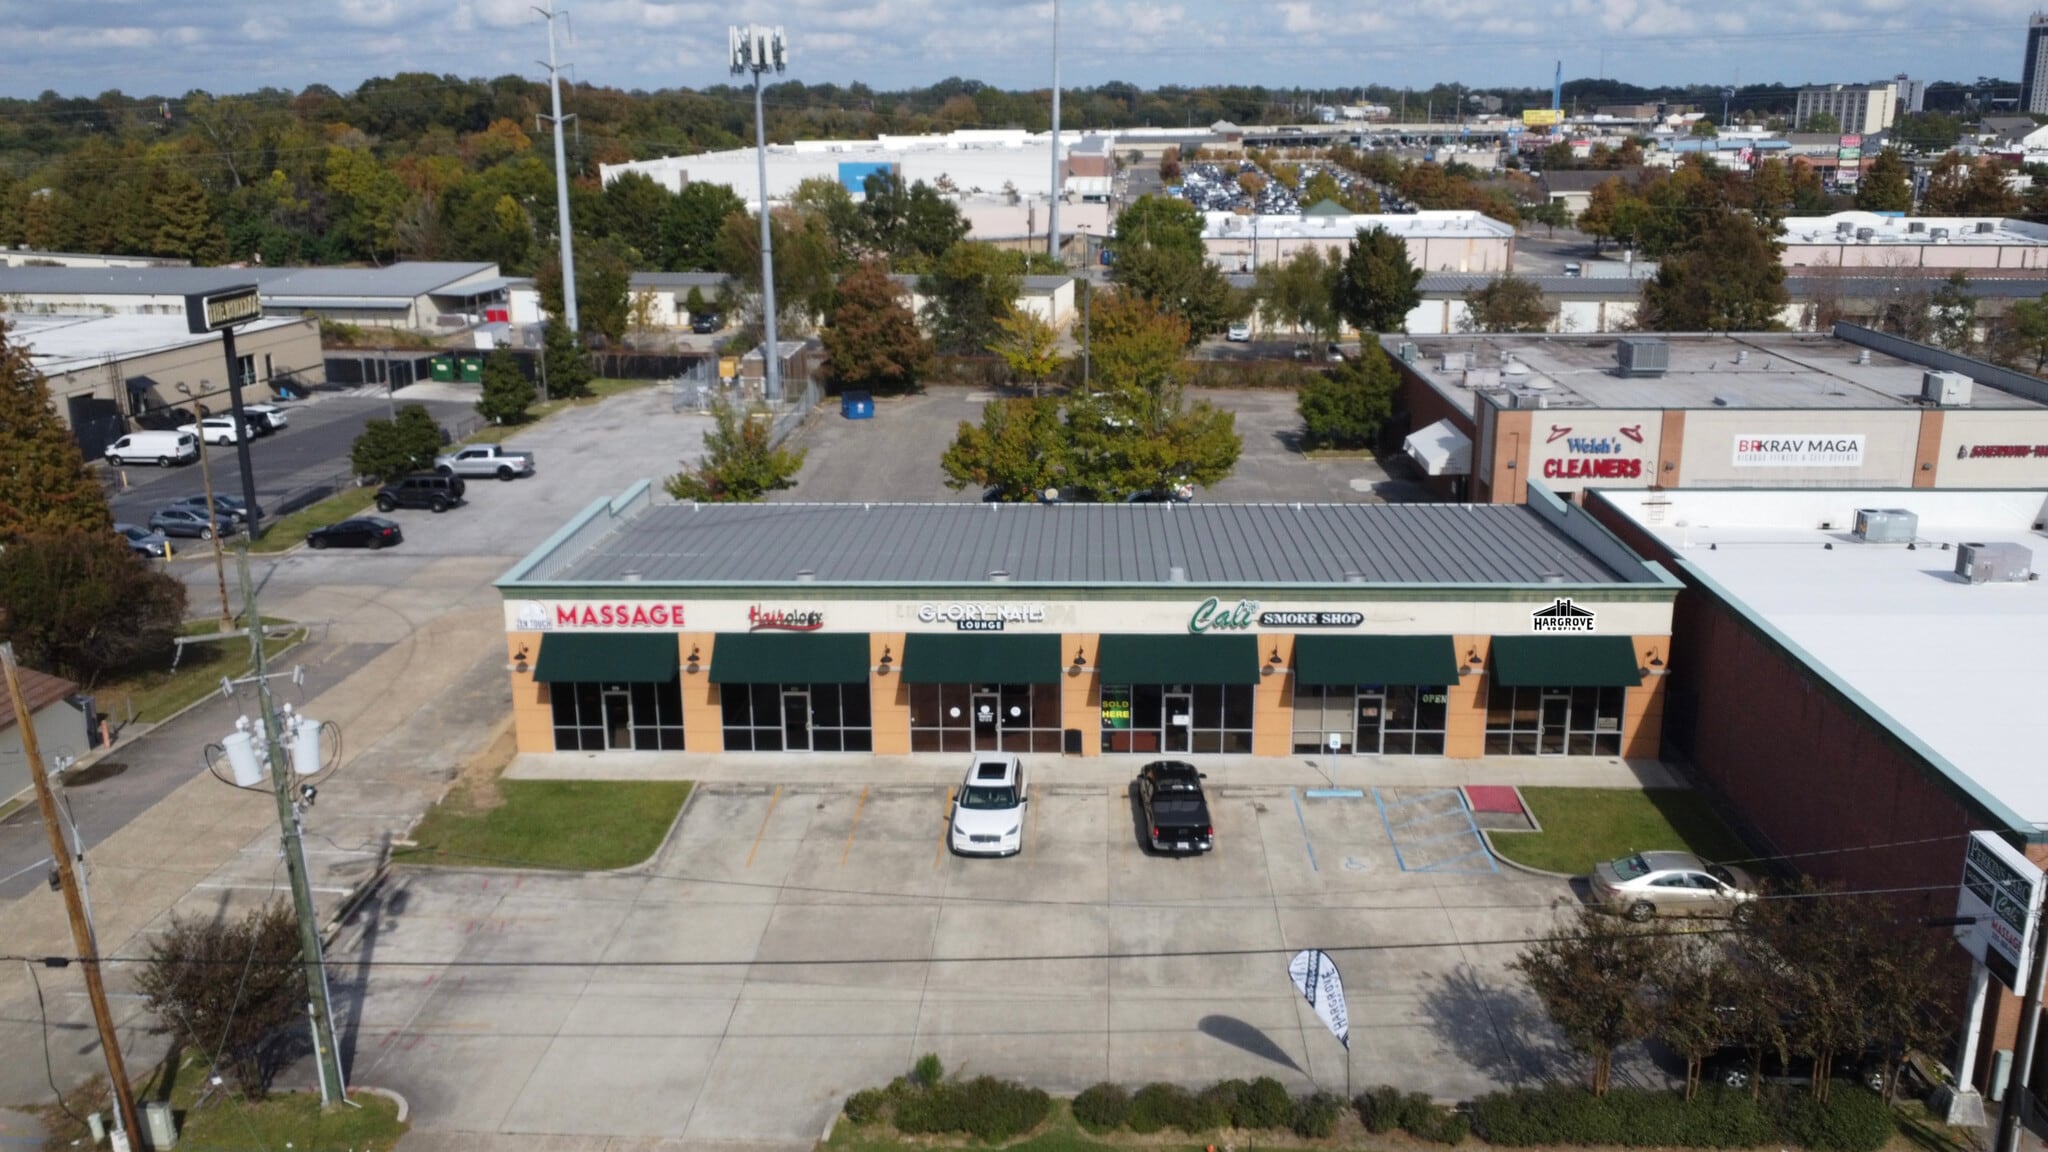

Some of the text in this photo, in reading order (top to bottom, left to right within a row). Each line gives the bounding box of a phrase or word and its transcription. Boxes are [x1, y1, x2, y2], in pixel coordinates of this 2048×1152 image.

[1808, 440, 1858, 452] MAGA
[1544, 458, 1642, 478] CLEANERS
[557, 605, 684, 626] MASSAGE
[919, 604, 1045, 622] GLORY NAILS
[1189, 598, 1251, 633] Cali
[1264, 613, 1361, 624] SMOKE SHOP
[960, 621, 1001, 629] LOUNGE
[1534, 618, 1594, 630] HARGROVE
[1423, 695, 1447, 703] OPEN
[1992, 919, 2022, 952] MASSAGE
[1321, 967, 1348, 1031] HARGROVE
